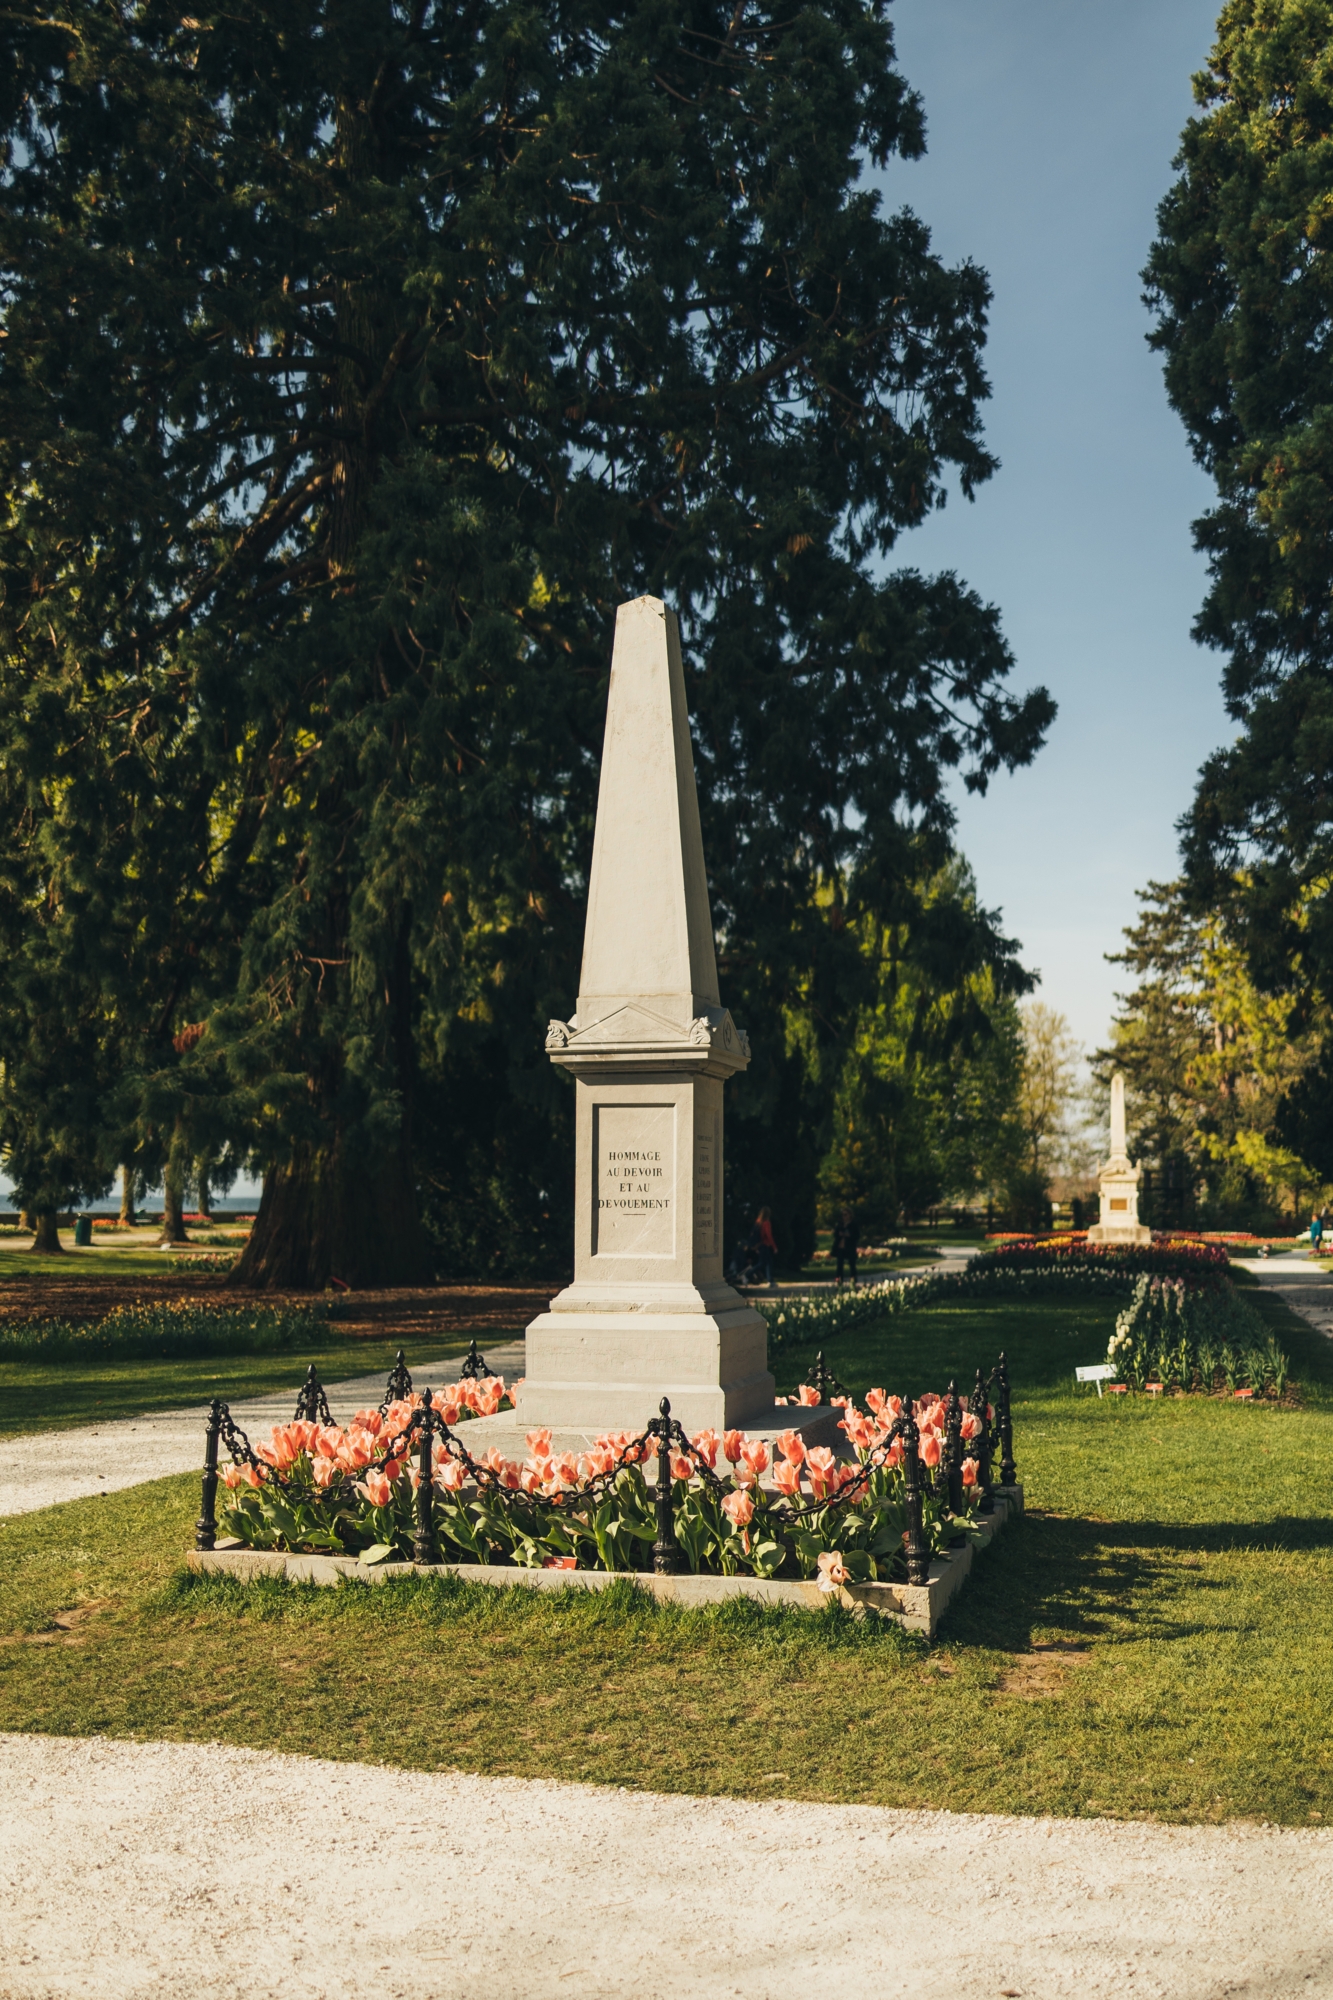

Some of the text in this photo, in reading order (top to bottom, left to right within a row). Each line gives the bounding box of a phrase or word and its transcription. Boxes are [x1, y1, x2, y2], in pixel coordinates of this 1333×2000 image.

[609, 1151, 661, 1161] HOMMAGE
[606, 1167, 663, 1177] AU DEVOIR
[620, 1183, 650, 1193] ET AU
[598, 1199, 671, 1209] DEVOUEMENT
